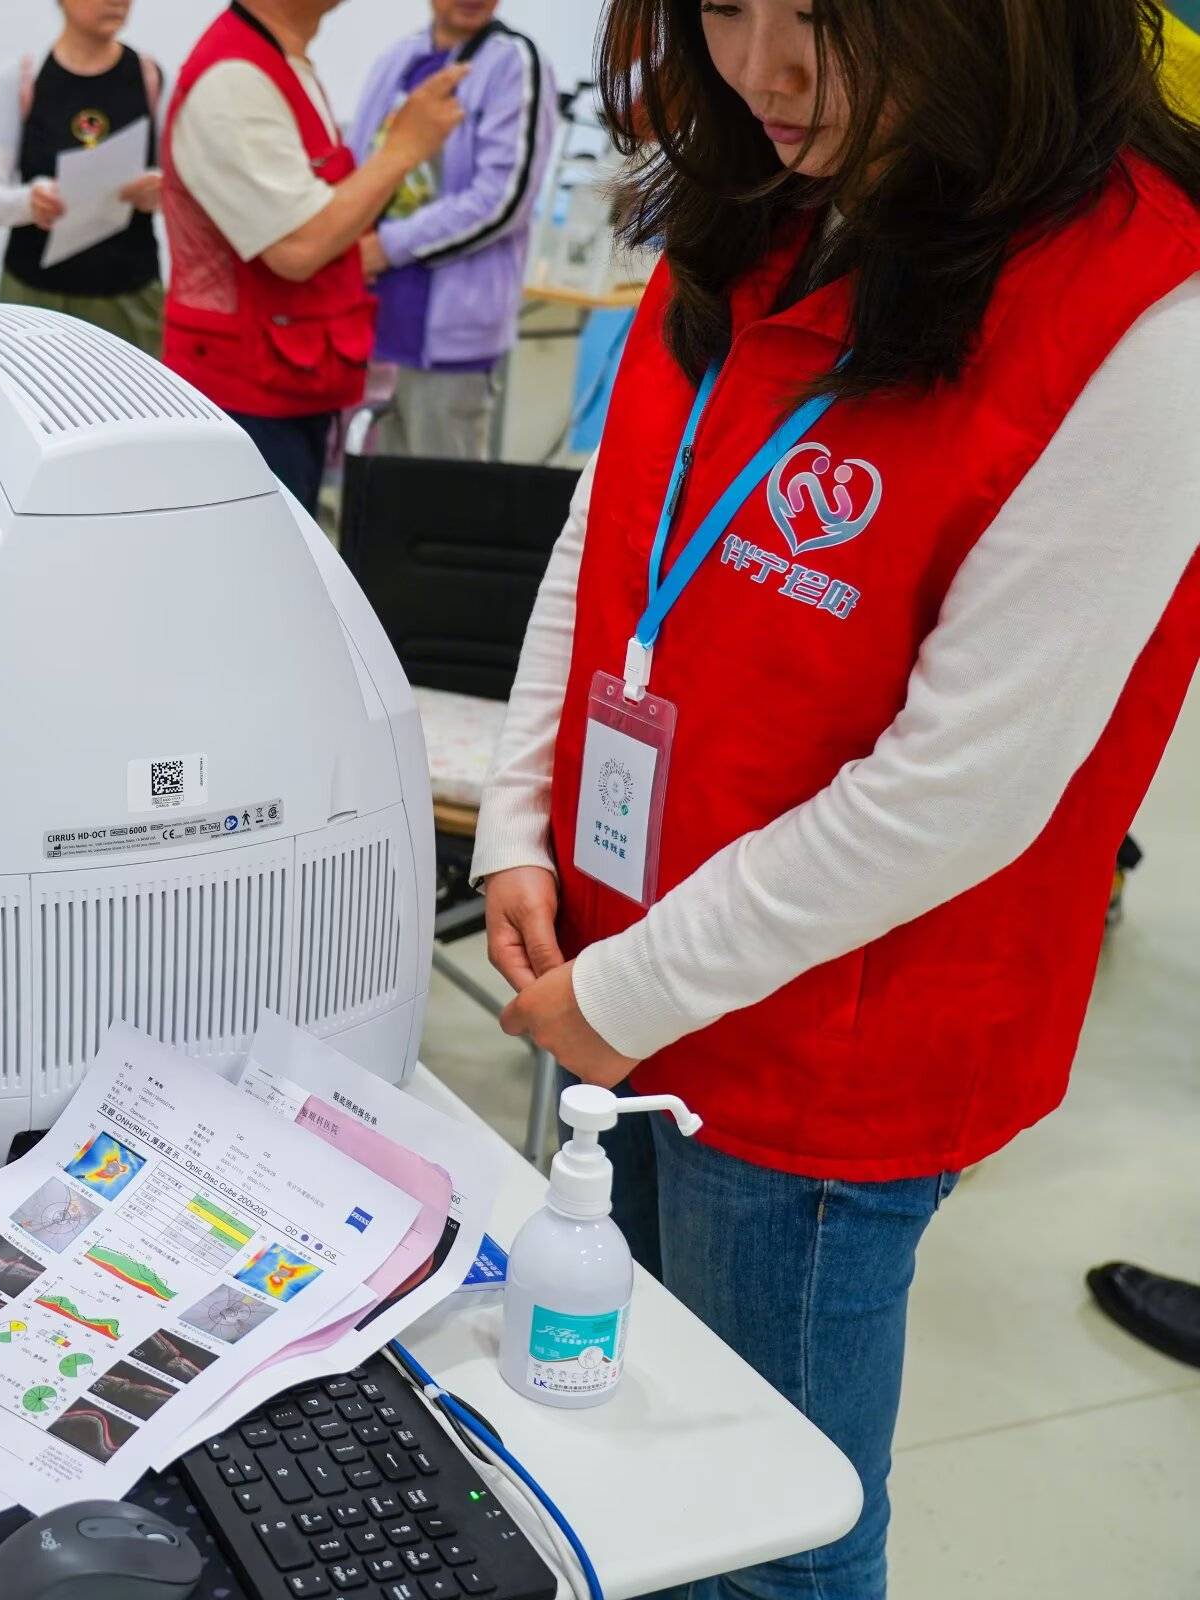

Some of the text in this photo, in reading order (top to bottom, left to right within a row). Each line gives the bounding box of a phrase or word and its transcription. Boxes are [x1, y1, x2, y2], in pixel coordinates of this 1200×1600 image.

[47, 833, 76, 843] CIRRUS
[77, 830, 106, 840] HD-OCT
[129, 825, 147, 835] 6000
[101, 1102, 115, 1118] 双眼
[185, 1160, 203, 1176] Optic
[203, 1172, 219, 1185] Disc
[219, 1182, 238, 1198] Cube
[238, 1194, 268, 1218] 200x200
[285, 1225, 298, 1236] OD
[324, 1250, 336, 1260] OS
[351, 1212, 369, 1226] ZEISS
